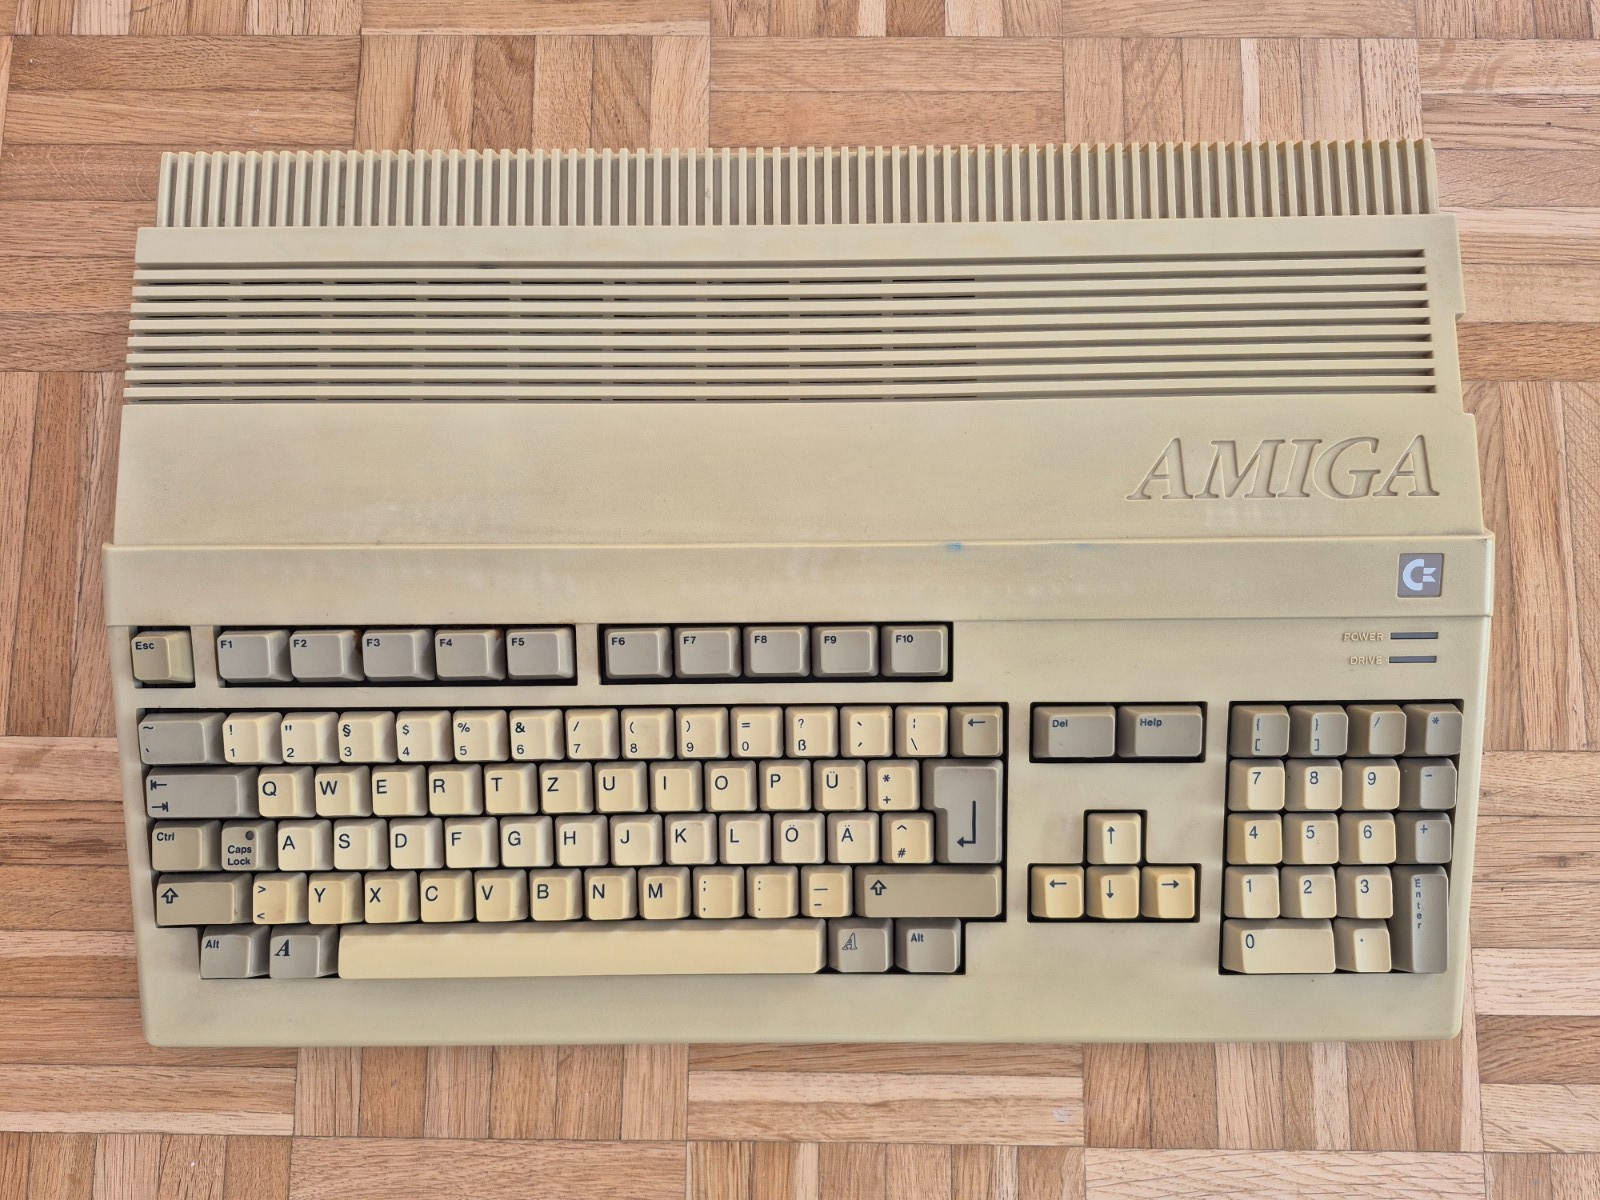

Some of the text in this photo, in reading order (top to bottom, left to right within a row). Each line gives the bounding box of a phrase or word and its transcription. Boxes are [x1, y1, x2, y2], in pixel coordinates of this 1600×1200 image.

[1126, 434, 1440, 500] AMIGA
[220, 639, 233, 649] F1
[293, 639, 308, 648] F2
[366, 638, 381, 648] F3
[439, 638, 453, 648] F4
[511, 637, 525, 647] F5
[611, 636, 626, 646] F6
[683, 635, 697, 645] F7
[754, 635, 768, 644] F8
[823, 635, 837, 645] F9
[895, 634, 914, 643] F10
[1343, 631, 1384, 642] POWER
[135, 641, 155, 651] Esc
[1349, 655, 1383, 665] DRIVE
[1052, 719, 1069, 728] Del
[1139, 717, 1163, 728] Help
[230, 747, 235, 758] 1
[286, 747, 295, 758] 2
[344, 746, 353, 757] 3
[402, 746, 410, 757] 4
[459, 745, 468, 756] 5
[516, 744, 525, 755] 6
[573, 743, 581, 754] 7
[630, 742, 638, 754] 8
[686, 741, 694, 753] 9
[741, 741, 750, 752] 0
[490, 777, 503, 792] T
[547, 776, 559, 793] Z
[602, 775, 616, 791] U
[714, 775, 729, 791] O
[770, 773, 782, 789] P
[826, 771, 839, 789] Ü
[1252, 771, 1262, 785] 7
[1309, 770, 1319, 785] 8
[1367, 771, 1377, 786] 9
[262, 780, 277, 797] Q
[319, 780, 338, 796] W
[376, 779, 388, 795] E
[433, 778, 446, 794] R
[156, 831, 175, 842] Ctrl
[451, 831, 463, 847] F
[507, 830, 521, 847] G
[563, 830, 576, 846] H
[620, 829, 630, 844] J
[675, 827, 687, 844] K
[729, 828, 740, 843] L
[785, 824, 799, 843] Ö
[841, 824, 854, 843] Ä
[1248, 825, 1259, 840] 4
[1306, 825, 1315, 840] 5
[1363, 824, 1373, 839] 6
[282, 835, 296, 851] A
[338, 833, 351, 849] S
[394, 833, 408, 849] D
[227, 844, 252, 857] Caps
[227, 857, 251, 867] Lock
[481, 884, 494, 901] V
[537, 883, 550, 900] B
[592, 883, 605, 900] N
[648, 882, 663, 899] M
[1245, 878, 1252, 893] 1
[1303, 879, 1313, 894] 2
[1360, 878, 1370, 894] 3
[314, 887, 326, 903] Y
[369, 887, 382, 903] X
[425, 885, 439, 902] C
[1414, 878, 1423, 929] Enter
[205, 938, 220, 950] Alt
[910, 932, 924, 943] Alt
[1245, 933, 1255, 949] 0
